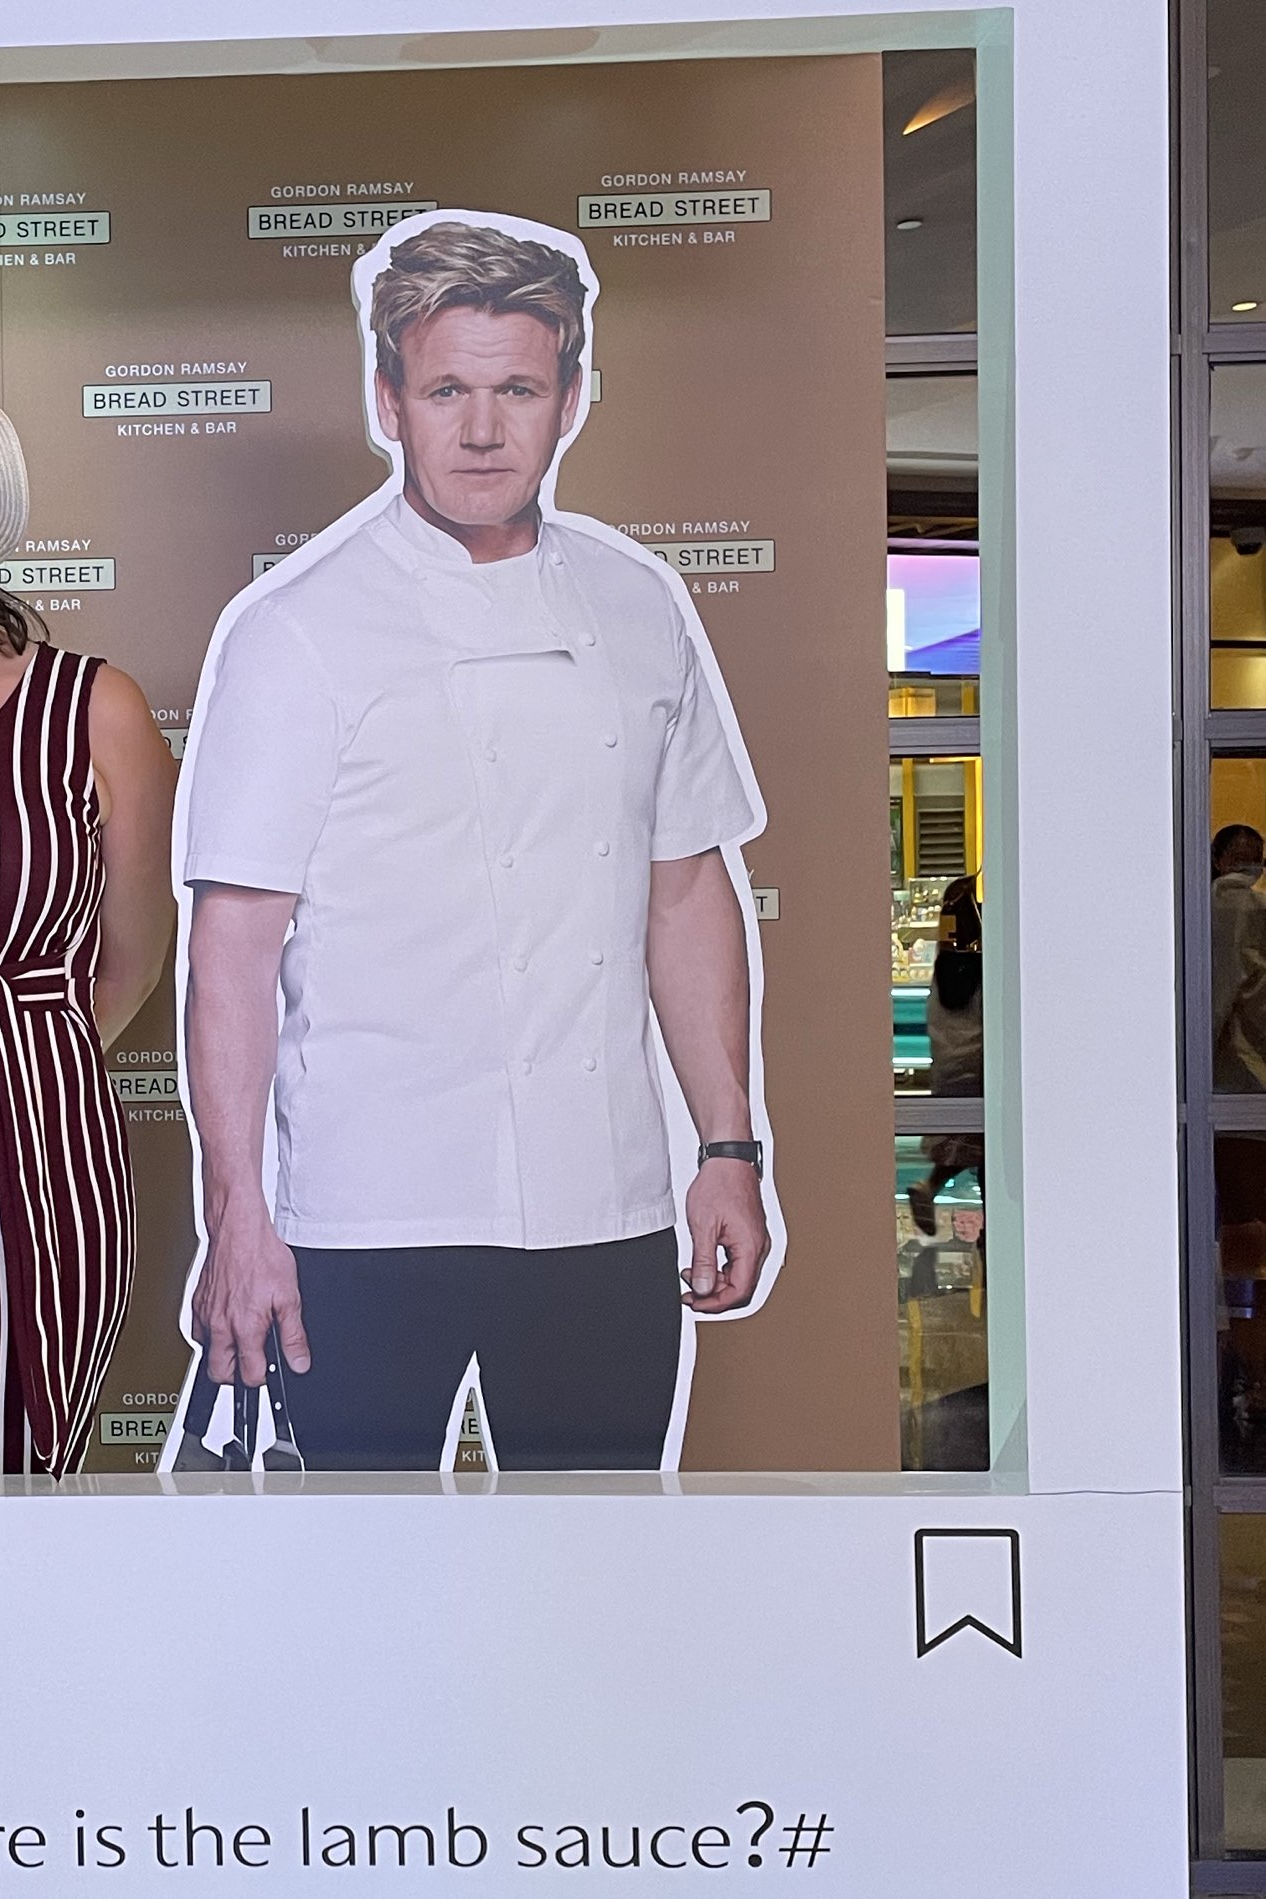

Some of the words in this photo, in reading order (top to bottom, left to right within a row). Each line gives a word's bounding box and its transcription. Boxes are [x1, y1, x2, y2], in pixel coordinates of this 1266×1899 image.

[601, 173, 672, 188] GORDON
[678, 169, 747, 184] RAMSAY
[20, 192, 86, 206] RAMSAY
[270, 184, 340, 199] GORDON
[347, 182, 414, 196] RAMSAY
[589, 201, 664, 220] BREAD
[674, 197, 760, 217] STREET
[16, 219, 99, 238] STREET
[258, 212, 333, 231] BREAD
[343, 209, 427, 228] STREE
[613, 232, 682, 247] KITCHEN
[687, 231, 698, 244] &
[703, 230, 735, 244] BAR
[29, 253, 39, 266] &
[44, 252, 76, 265] BAR
[283, 243, 351, 258] KITCHEN
[356, 243, 366, 256] &
[105, 364, 174, 378] GORDON
[181, 361, 247, 375] RAMSAY
[94, 391, 167, 410] BREAD
[177, 388, 261, 408] STREET
[117, 423, 185, 436] KITCHEN
[190, 422, 200, 435] &
[205, 421, 237, 434] BAR
[682, 520, 750, 534] RAMSAY
[25, 539, 92, 552] RAMSAY
[678, 547, 764, 567] STREET
[22, 565, 105, 584] STREET
[691, 582, 702, 593] &
[707, 581, 740, 593] BAR
[34, 599, 45, 611] &
[49, 599, 81, 611] BAR
[116, 1051, 174, 1063] GORDO
[128, 1109, 184, 1121] KITCHE
[122, 1393, 180, 1405] GORDO
[110, 1419, 167, 1437] BREA
[75, 1809, 126, 1868] is
[147, 1806, 271, 1868] the
[301, 1806, 488, 1868] lamb
[517, 1800, 835, 1869] sauce?#
